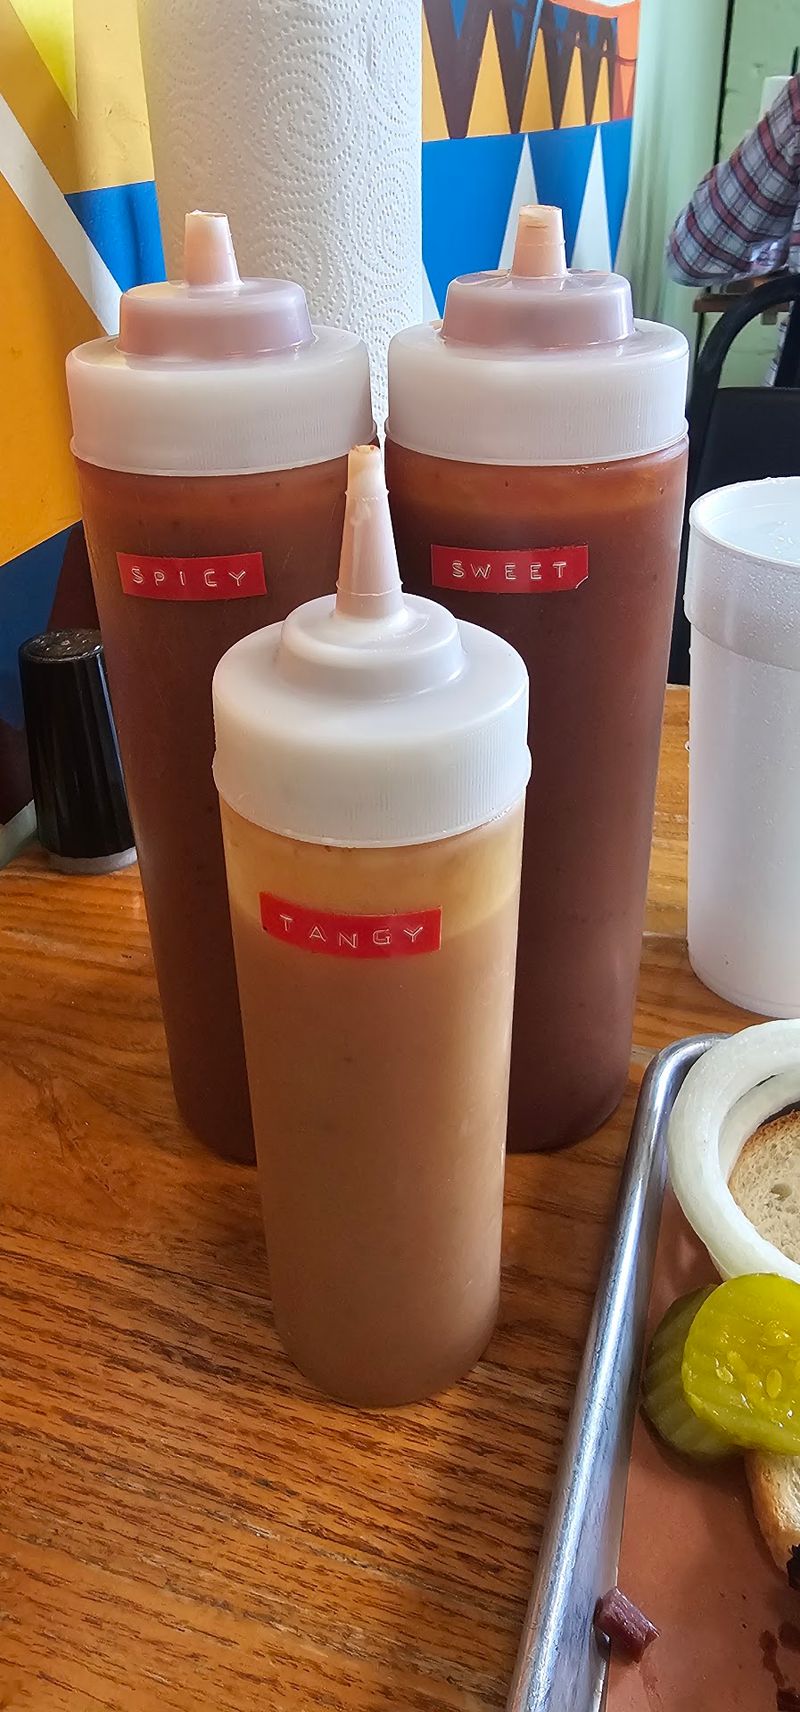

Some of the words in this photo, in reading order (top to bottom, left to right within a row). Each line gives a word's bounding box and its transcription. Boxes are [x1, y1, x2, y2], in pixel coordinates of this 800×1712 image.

[130, 566, 247, 588] SPICY
[451, 560, 567, 580] SWEET
[279, 914, 424, 949] TANGY
